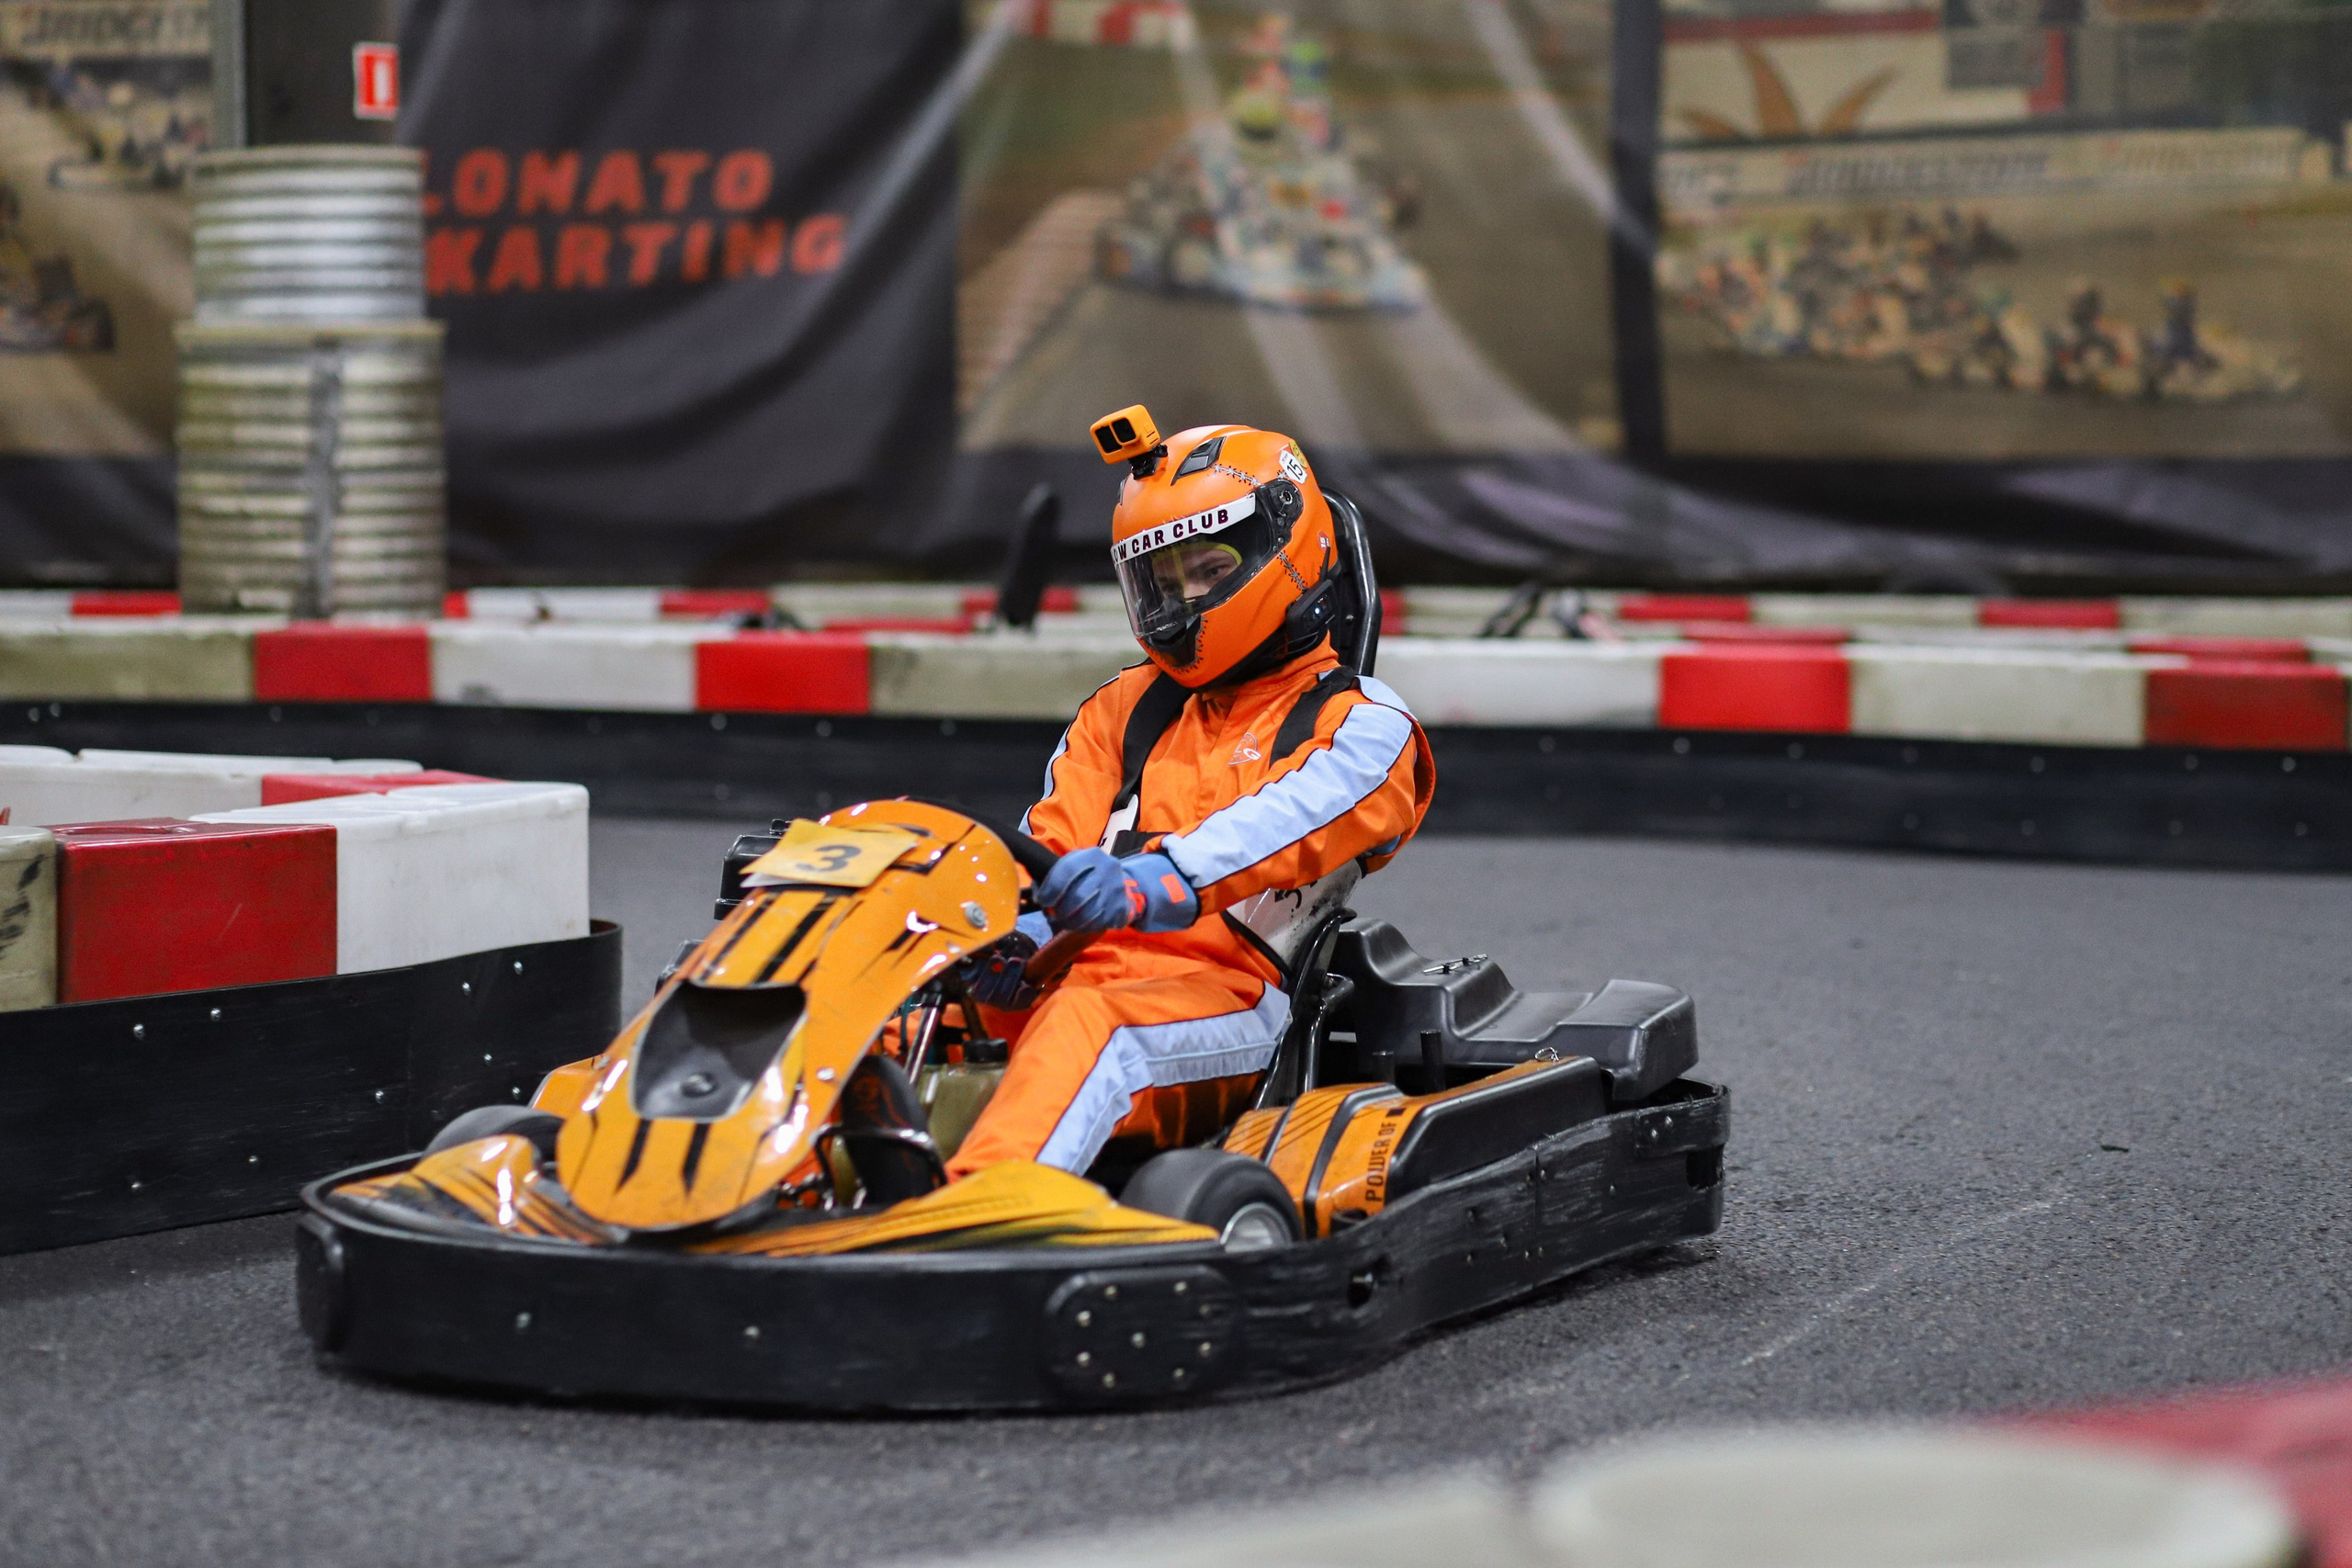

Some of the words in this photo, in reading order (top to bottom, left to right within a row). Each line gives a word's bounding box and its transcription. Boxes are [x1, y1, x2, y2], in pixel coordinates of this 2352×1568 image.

[424, 213, 847, 296] KARTING
[1286, 458, 1304, 480] 15
[1131, 529, 1165, 555] CAR
[1172, 508, 1229, 539] CLUB
[795, 844, 862, 873] 3
[1364, 1139, 1392, 1202] POWER
